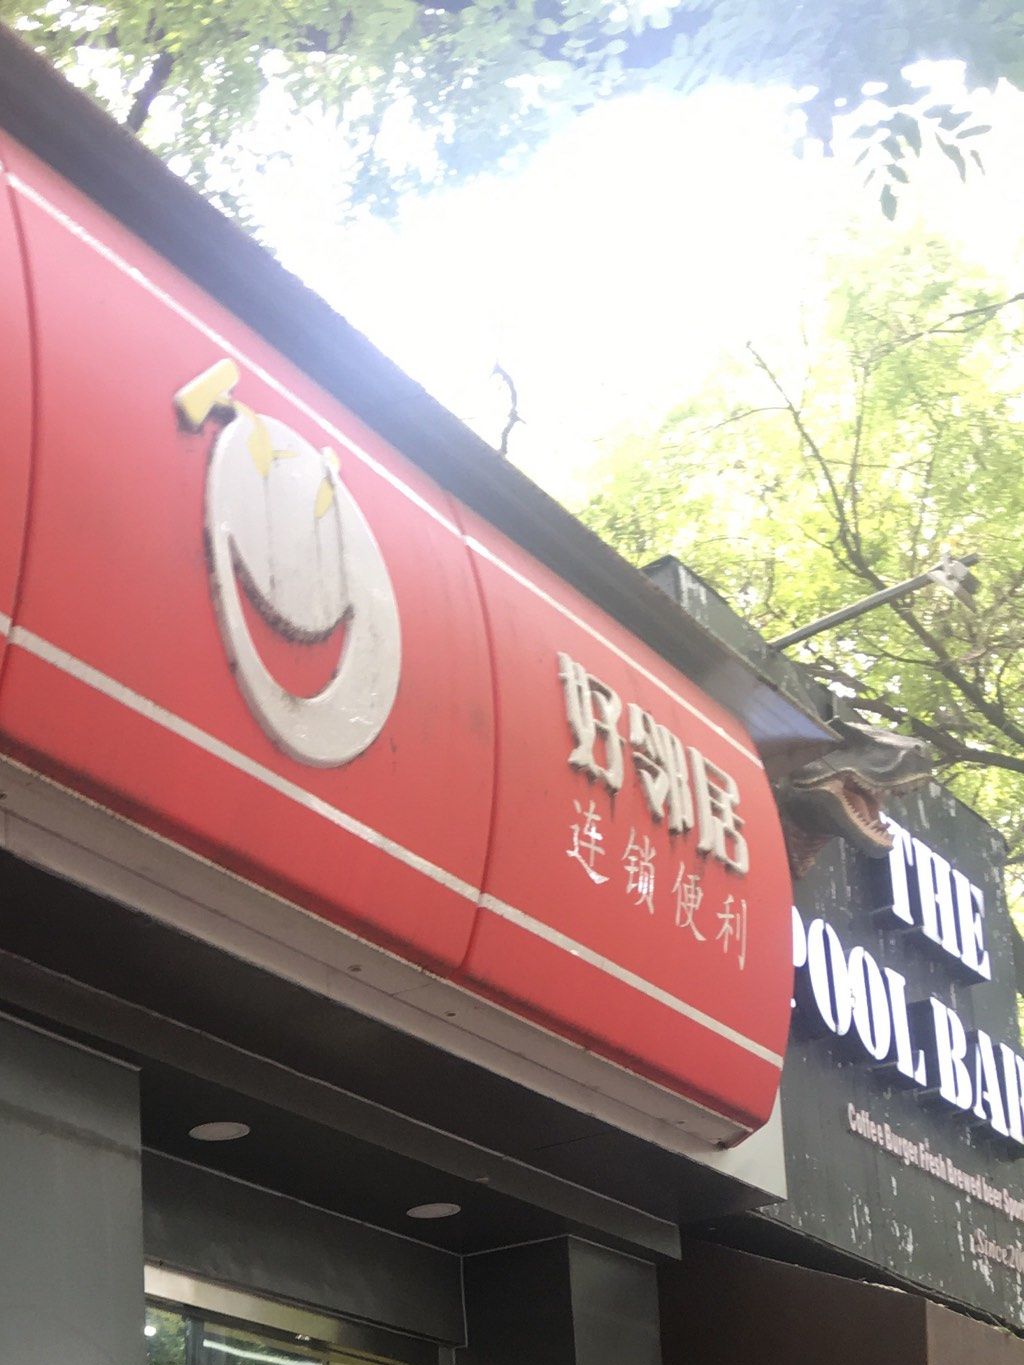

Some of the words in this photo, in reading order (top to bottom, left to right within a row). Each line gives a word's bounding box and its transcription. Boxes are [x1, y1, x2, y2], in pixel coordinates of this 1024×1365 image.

[558, 651, 749, 875] 好邻居
[566, 799, 748, 971] 连锁便利
[879, 810, 991, 981] THE
[847, 1102, 884, 1146] Coffee
[883, 1122, 919, 1166] Burger
[918, 1142, 947, 1181] Fresh
